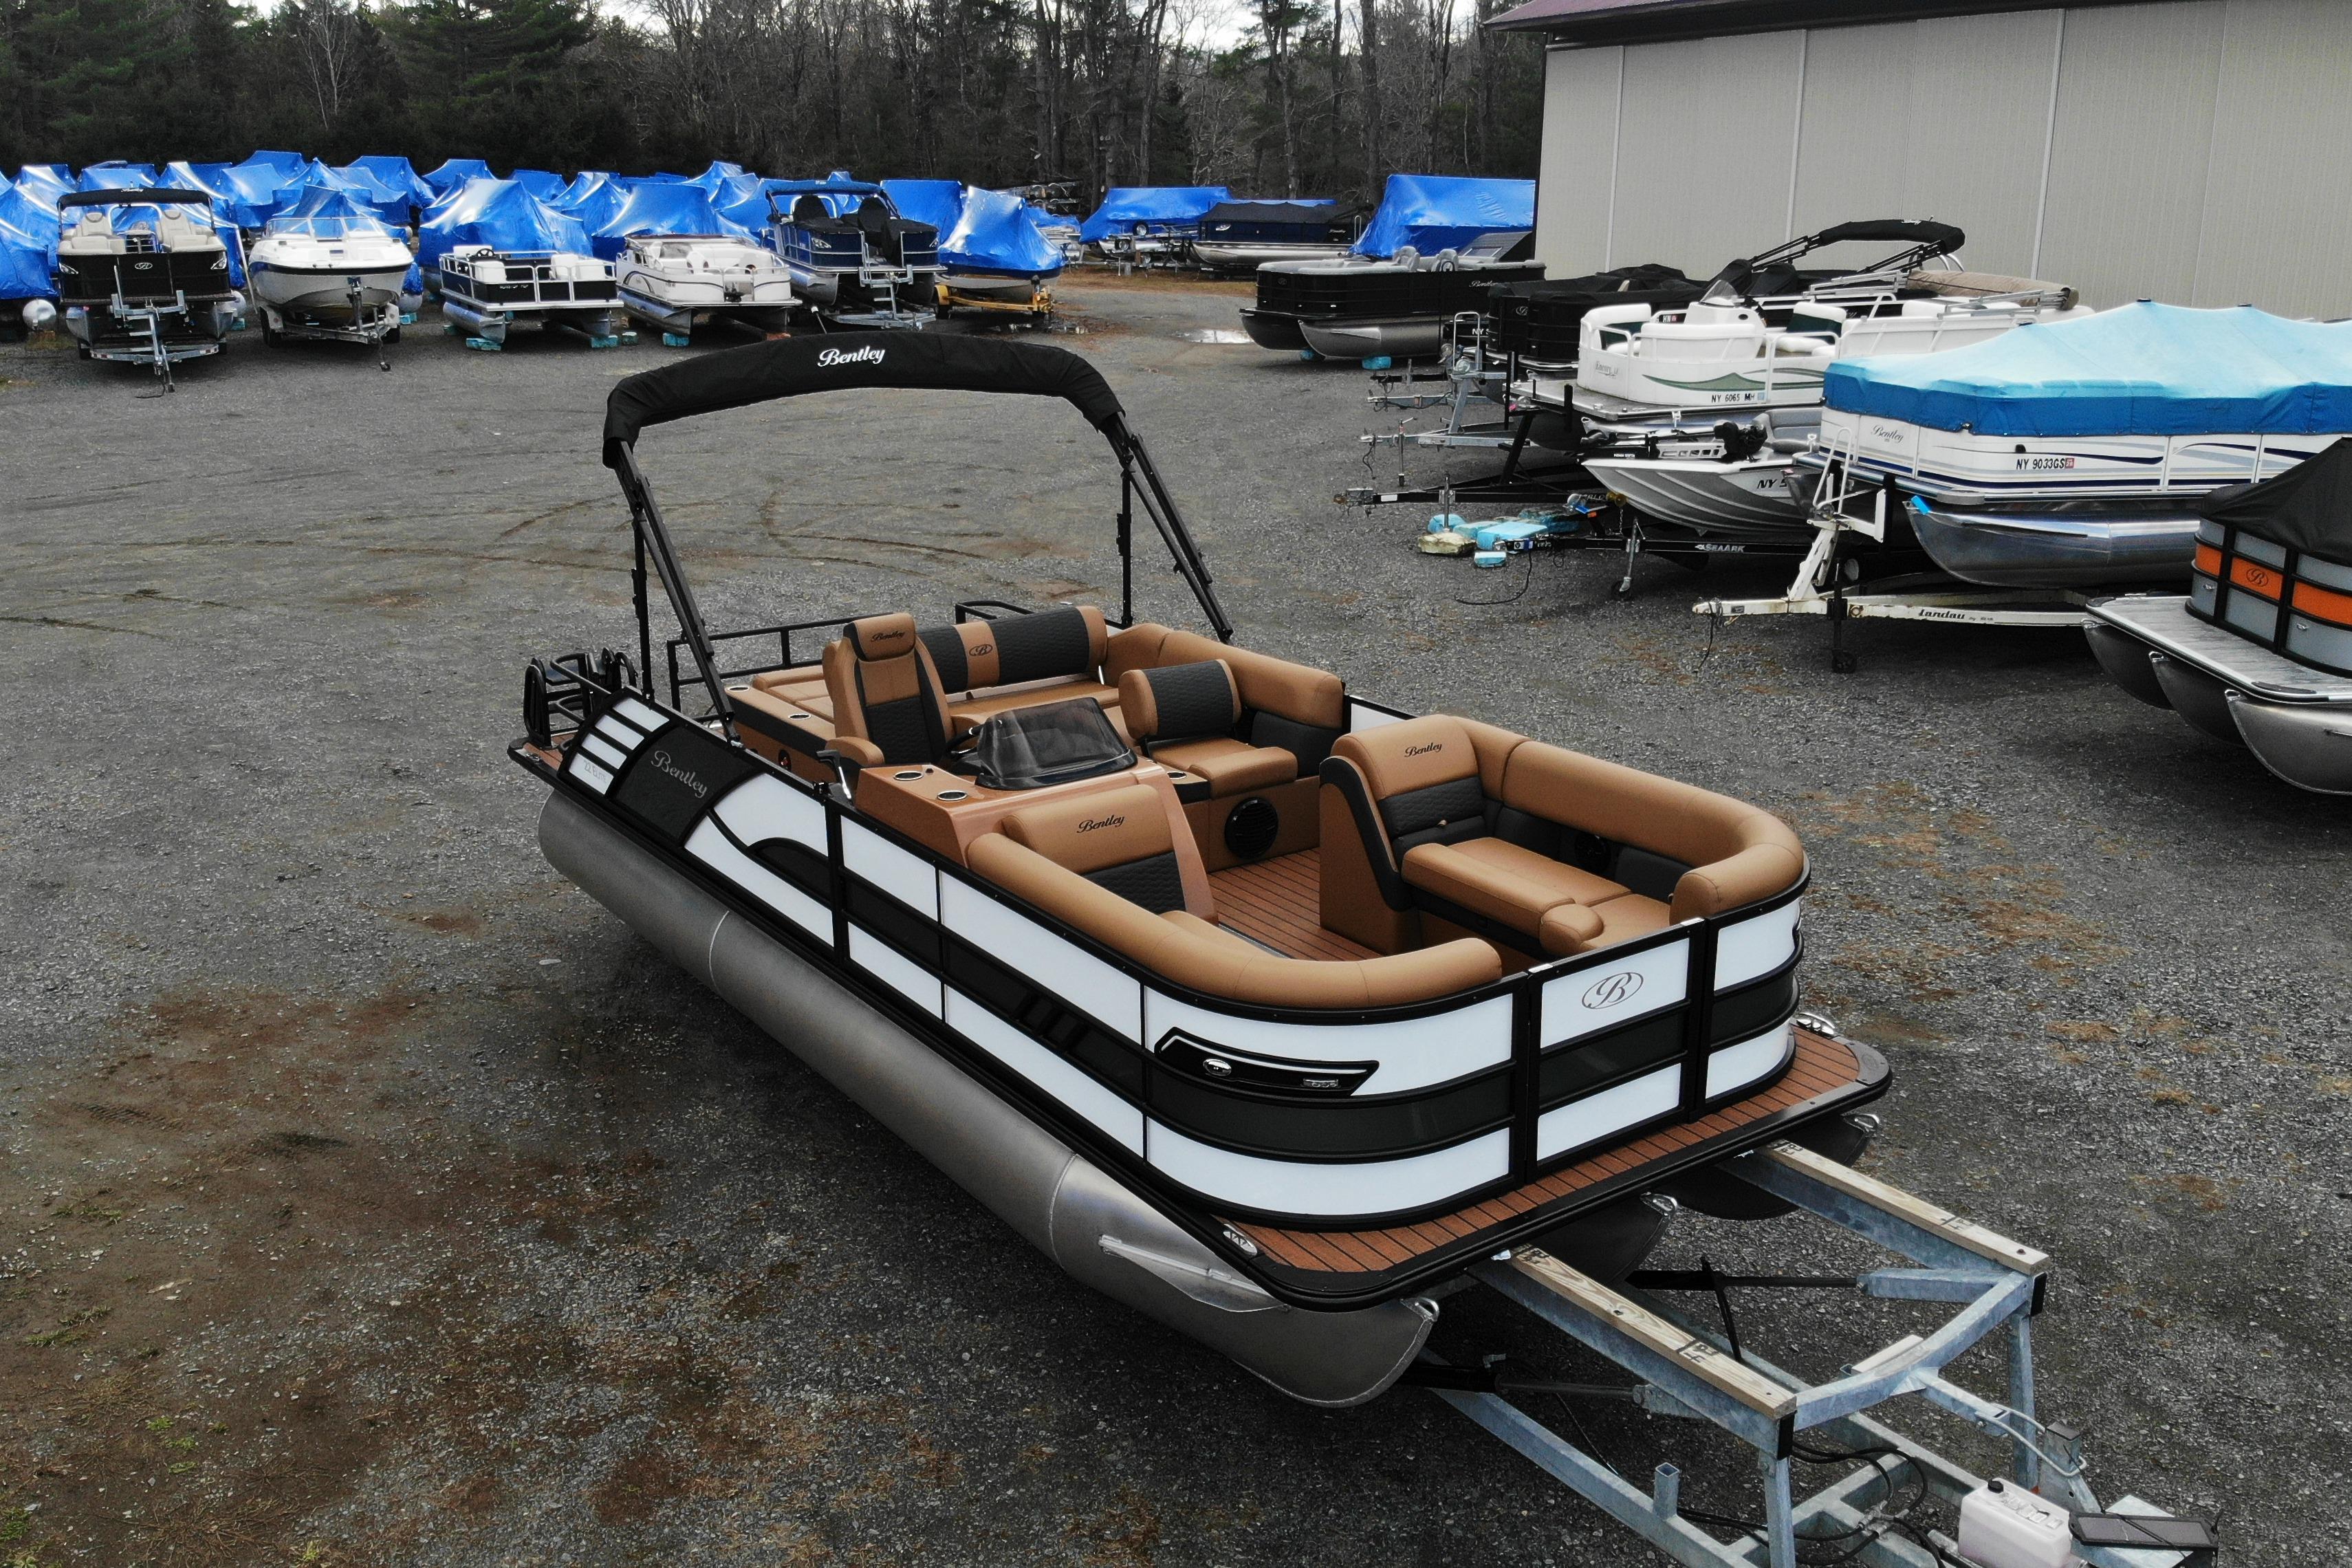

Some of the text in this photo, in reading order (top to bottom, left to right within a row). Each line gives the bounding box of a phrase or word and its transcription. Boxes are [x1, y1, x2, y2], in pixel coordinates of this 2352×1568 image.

[817, 345, 886, 367] Bentley
[1712, 395, 1721, 403] NY
[1871, 424, 1904, 444] Bentley
[2016, 459, 2029, 470] NY
[2033, 457, 2065, 469] 9033GS
[1756, 479, 1777, 489] NY
[1919, 609, 1966, 620] Landau
[871, 631, 905, 642] Bentley
[1404, 742, 1442, 758] Bentley
[651, 750, 708, 798] Bentley
[1076, 815, 1124, 834] Bentley
